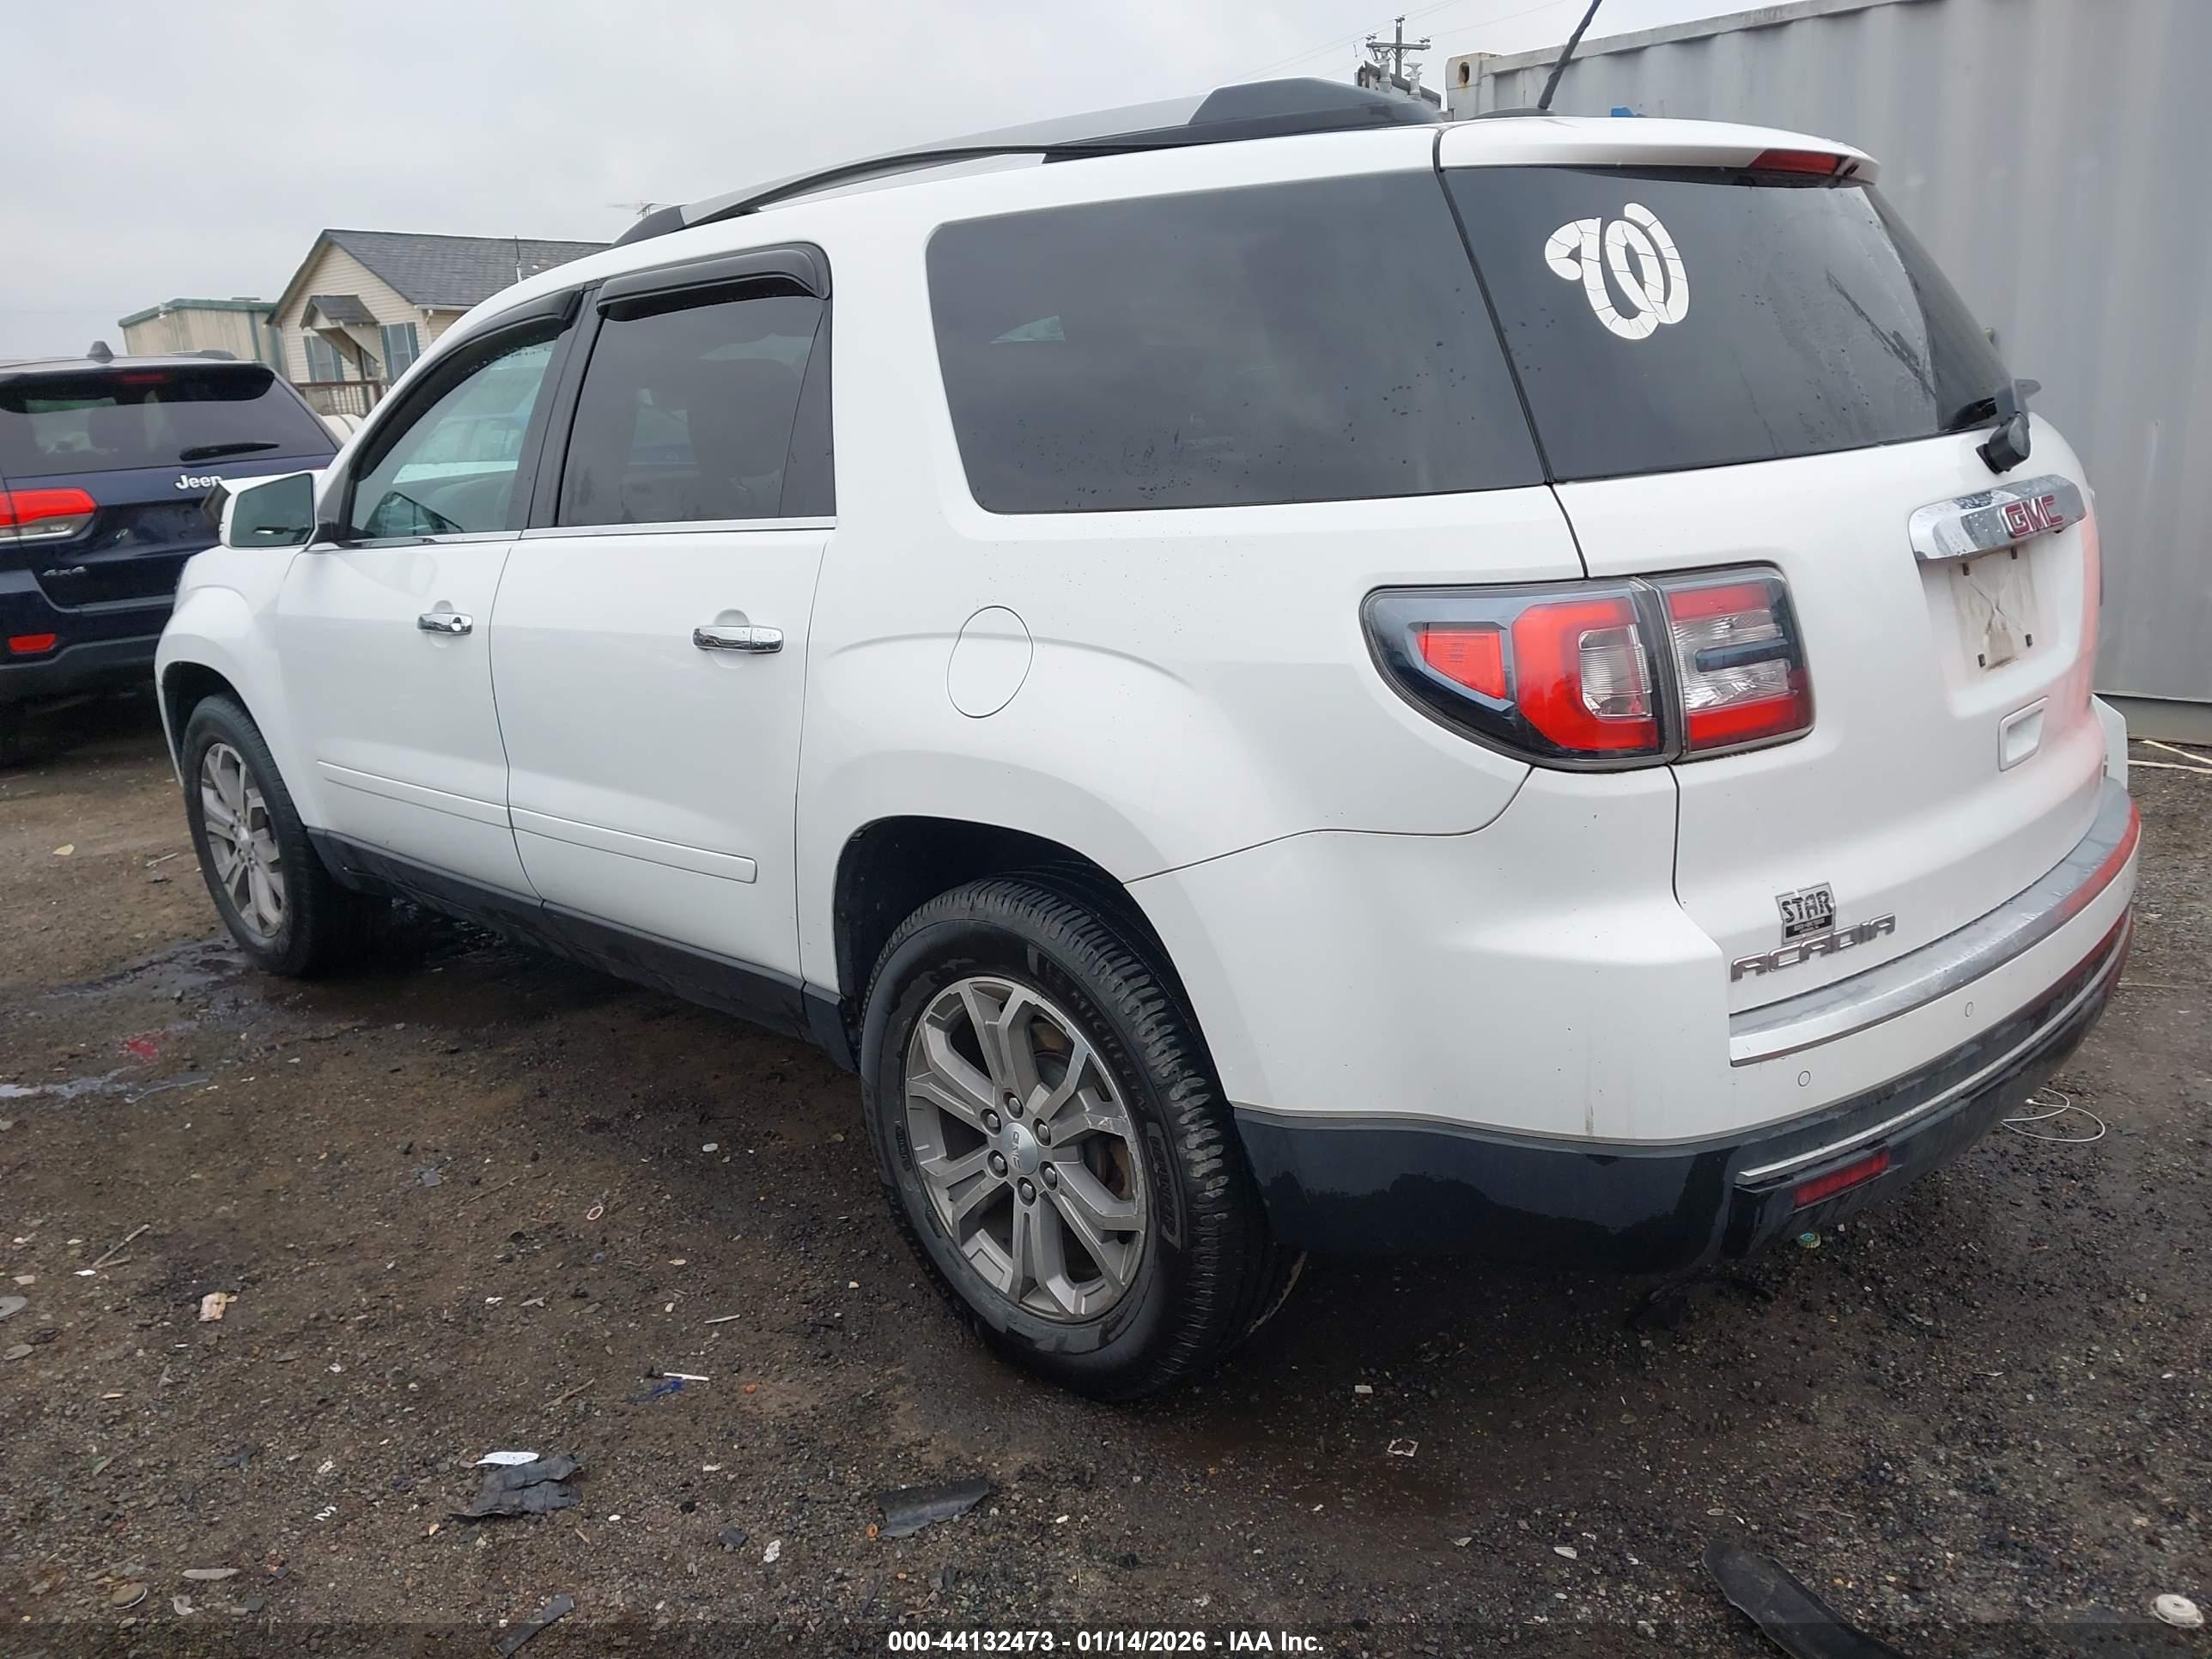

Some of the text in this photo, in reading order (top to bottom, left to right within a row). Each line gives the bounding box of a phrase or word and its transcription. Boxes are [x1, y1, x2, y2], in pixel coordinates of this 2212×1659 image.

[2002, 494, 2064, 537] GMC
[1780, 890, 1833, 924] STAR
[1730, 912, 1896, 982] ACADIA
